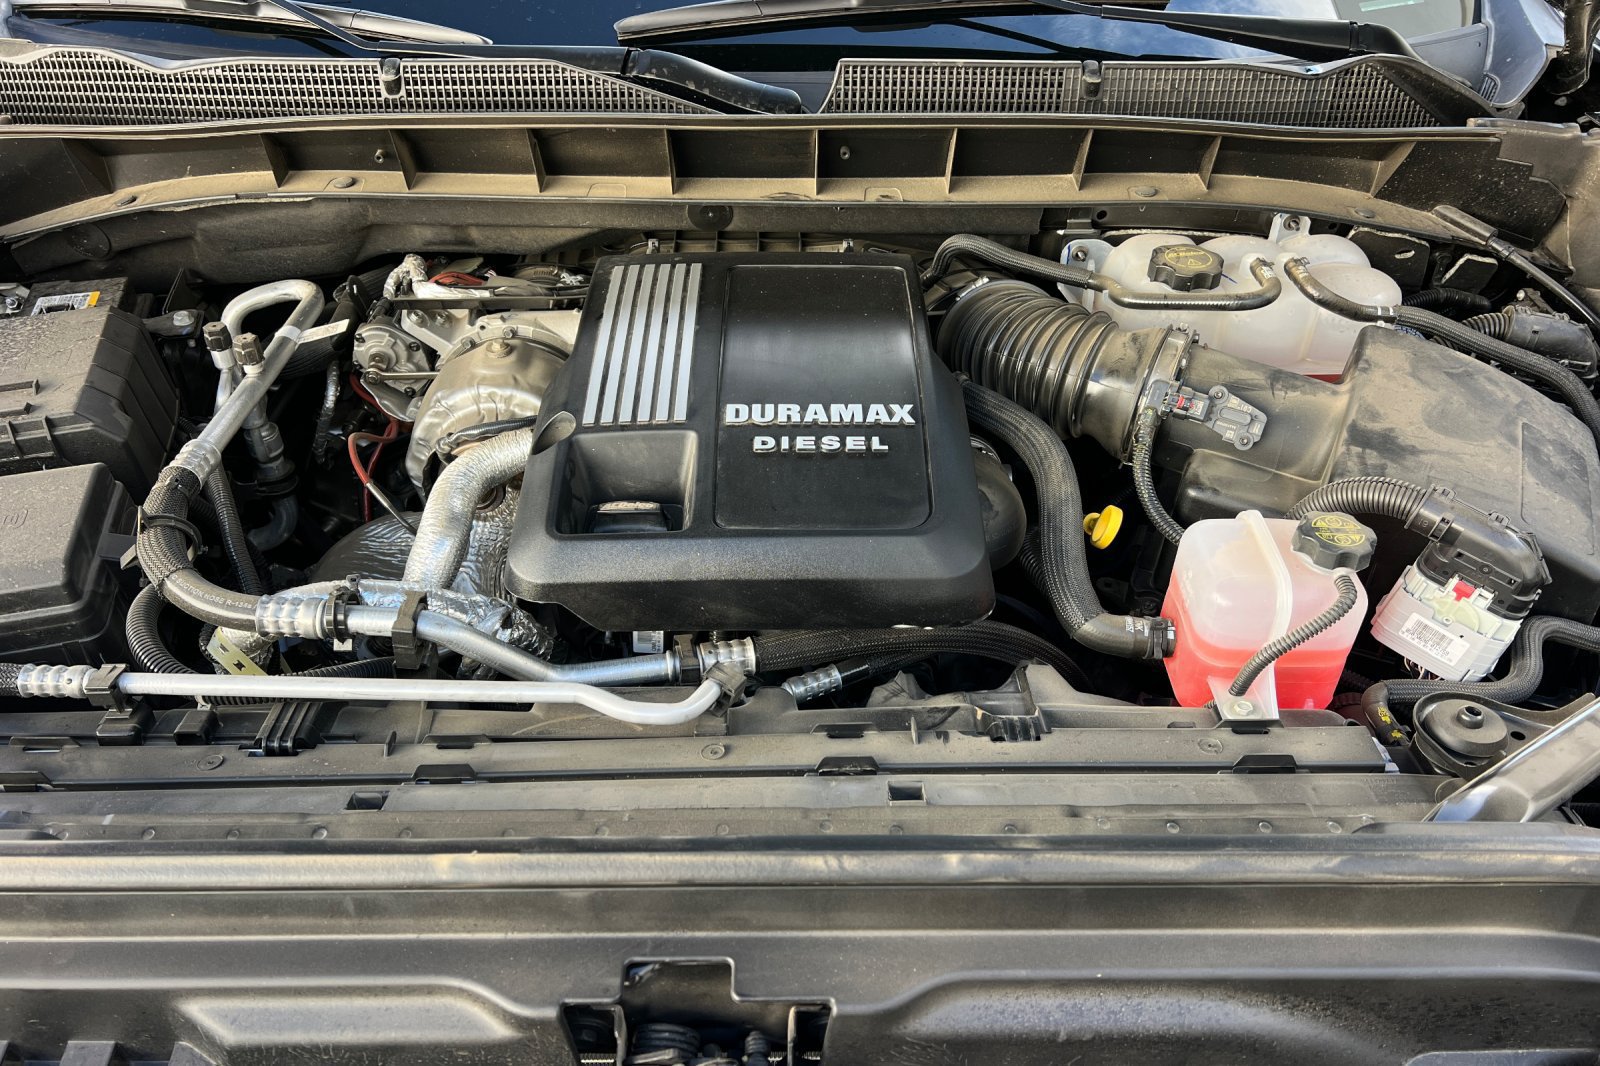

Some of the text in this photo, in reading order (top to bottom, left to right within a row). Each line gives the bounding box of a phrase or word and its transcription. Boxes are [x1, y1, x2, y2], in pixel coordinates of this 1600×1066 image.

[725, 403, 916, 425] DURAMAX
[753, 435, 889, 453] DIESEL
[176, 578, 204, 598] SUCTION
[204, 593, 225, 604] HOSE
